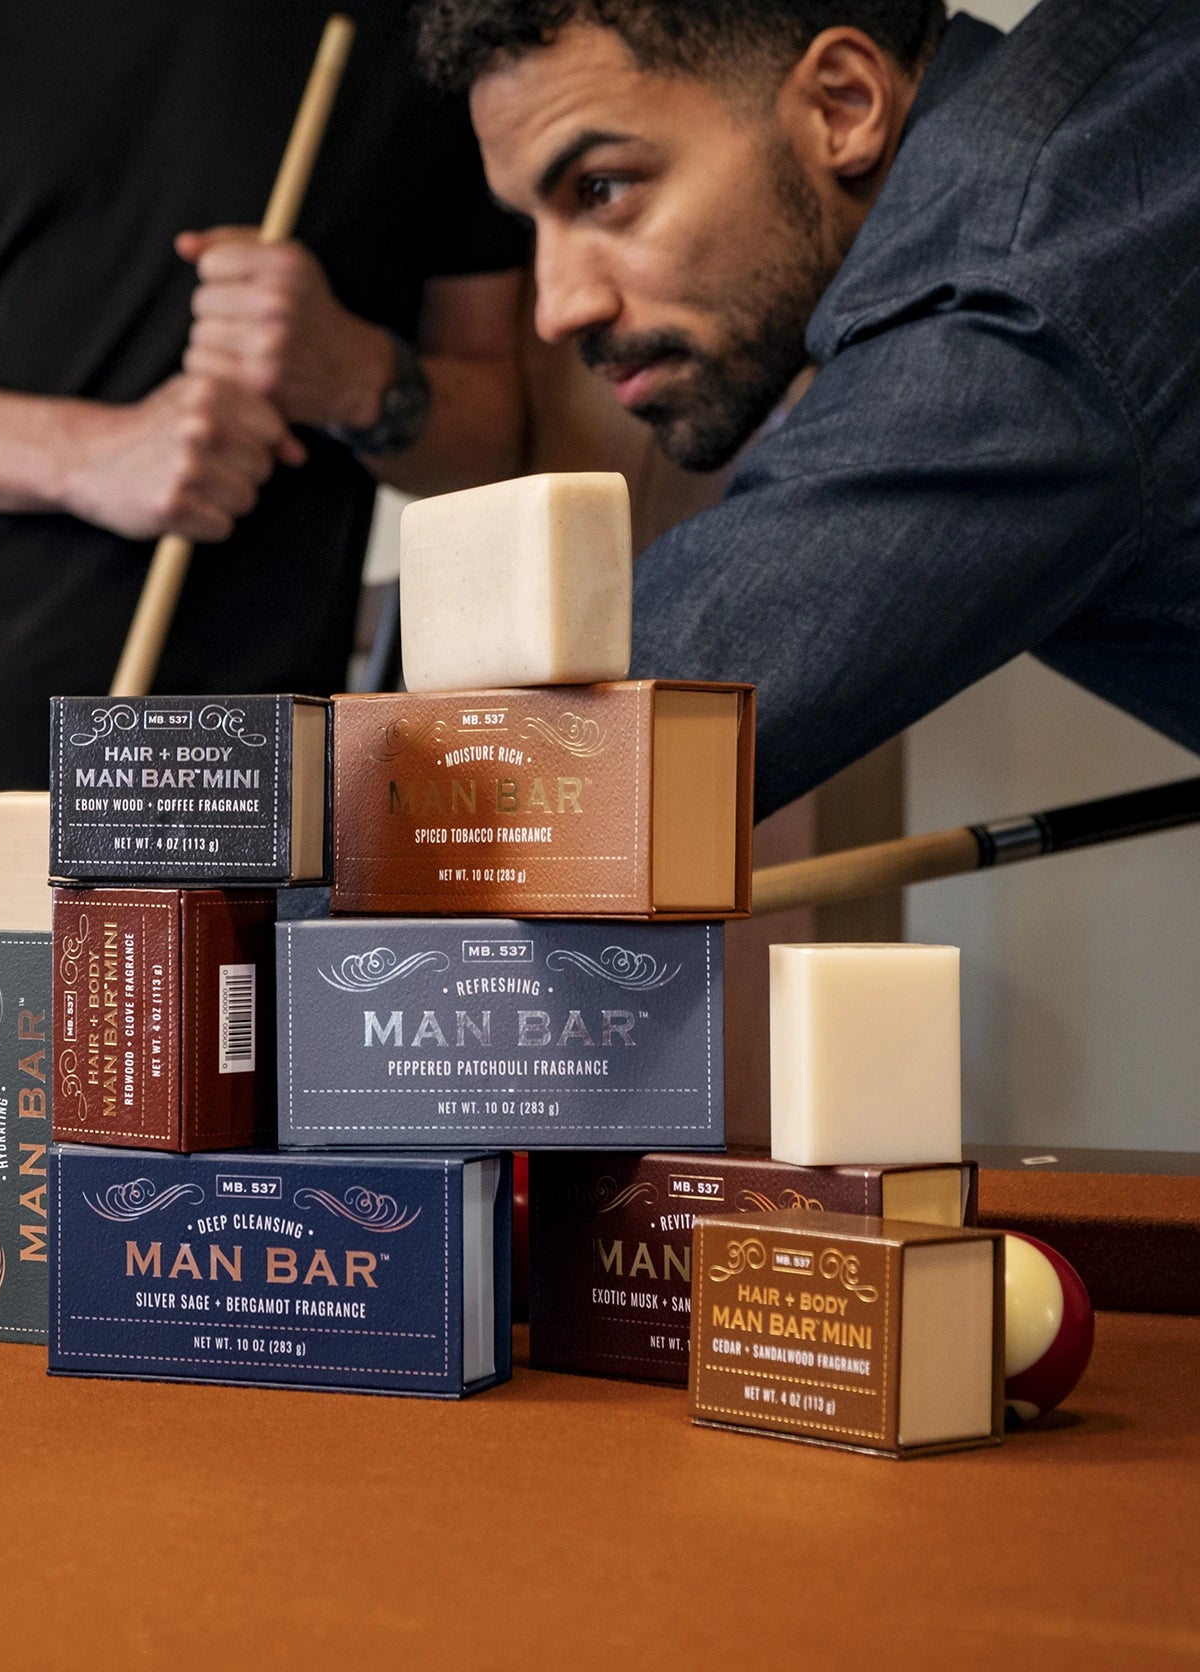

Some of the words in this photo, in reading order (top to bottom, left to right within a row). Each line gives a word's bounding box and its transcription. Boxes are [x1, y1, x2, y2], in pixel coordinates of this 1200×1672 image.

[169, 716, 188, 724] 537
[462, 714, 481, 725] MB.
[484, 713, 505, 724] 537
[105, 747, 153, 761] HAIR
[177, 747, 232, 761] BODY
[445, 746, 494, 767] MOISTURE
[498, 747, 523, 765] RICH
[76, 769, 133, 787] MAN
[203, 770, 260, 788] MINI
[76, 799, 108, 810] EBONY
[113, 800, 143, 811] WOOD
[157, 800, 194, 811] COFFEE
[199, 800, 259, 812] FRAGRANCE
[389, 780, 476, 814] MAN
[115, 838, 133, 849] NET
[135, 838, 152, 849] WT.
[157, 838, 162, 849] 4
[167, 838, 178, 849] OZ
[183, 838, 205, 851] (113
[209, 839, 219, 851] g)
[415, 829, 447, 843] SPICED
[451, 828, 493, 843] TOBACCO
[497, 827, 552, 842] FRAGRANCE
[439, 869, 452, 881] NET
[455, 869, 468, 881] WT.
[472, 869, 481, 881] 10
[484, 869, 494, 881] OZ
[497, 870, 515, 882] (283
[518, 870, 526, 883] g)
[104, 922, 118, 981] MINI
[469, 946, 494, 956] MB.
[500, 946, 527, 956] 537
[125, 933, 135, 998] FRAGRANCE
[152, 965, 162, 975] g)
[89, 951, 100, 1008] BODY
[457, 978, 541, 997] REFRESHING
[152, 979, 162, 1003] (113
[125, 1002, 135, 1036] CLOVE
[152, 1007, 161, 1020] OZ
[364, 1011, 491, 1047] MAN
[152, 1036, 161, 1054] WT.
[88, 1034, 99, 1085] HAIR
[152, 1058, 161, 1077] NET
[388, 1061, 451, 1075] PEPPERED
[457, 1061, 528, 1075] PATCHOULI
[534, 1061, 609, 1075] FRAGRANCE
[103, 1055, 117, 1117] MAN
[125, 1052, 134, 1105] REDWOOD
[438, 1102, 457, 1114] NET
[462, 1102, 480, 1114] WT.
[485, 1102, 497, 1114] 10
[502, 1102, 515, 1114] OZ
[520, 1102, 545, 1116] (283
[549, 1103, 559, 1116] g)
[223, 1182, 247, 1192] MB.
[252, 1183, 277, 1194] 537
[673, 1181, 694, 1192] MB.
[698, 1183, 719, 1194] 537
[19, 1142, 48, 1263] MAN
[197, 1217, 228, 1234] DEEP
[233, 1215, 303, 1238] CLEANSING
[125, 1240, 242, 1282] MAN
[592, 1239, 690, 1282] MAN
[776, 1255, 791, 1266] MB.
[794, 1257, 811, 1268] 537
[136, 1292, 175, 1308] SILVER
[181, 1294, 209, 1310] SAGE
[226, 1296, 290, 1314] BERGAMOT
[296, 1299, 365, 1318] FRAGRANCE
[592, 1288, 626, 1306] EXOTIC
[631, 1292, 658, 1309] MUSK
[738, 1285, 780, 1307] HAIR
[800, 1292, 848, 1316] BODY
[712, 1305, 762, 1333] MAN
[822, 1320, 872, 1349] MINI
[194, 1336, 210, 1349] NET
[215, 1338, 232, 1350] WT.
[237, 1338, 247, 1351] 10
[253, 1339, 264, 1352] OZ
[269, 1339, 293, 1354] (283
[296, 1342, 306, 1356] g)
[651, 1336, 665, 1348] NET
[669, 1338, 683, 1351] WT.
[712, 1338, 741, 1355] CEDAR
[753, 1344, 814, 1367] SANDALWOOD
[817, 1353, 870, 1376] FRAGRANCE
[745, 1386, 760, 1400] NET
[763, 1389, 778, 1404] WT.
[781, 1391, 786, 1405] 4
[789, 1392, 800, 1408] OZ
[803, 1395, 823, 1411] (113
[826, 1399, 835, 1416] g)
